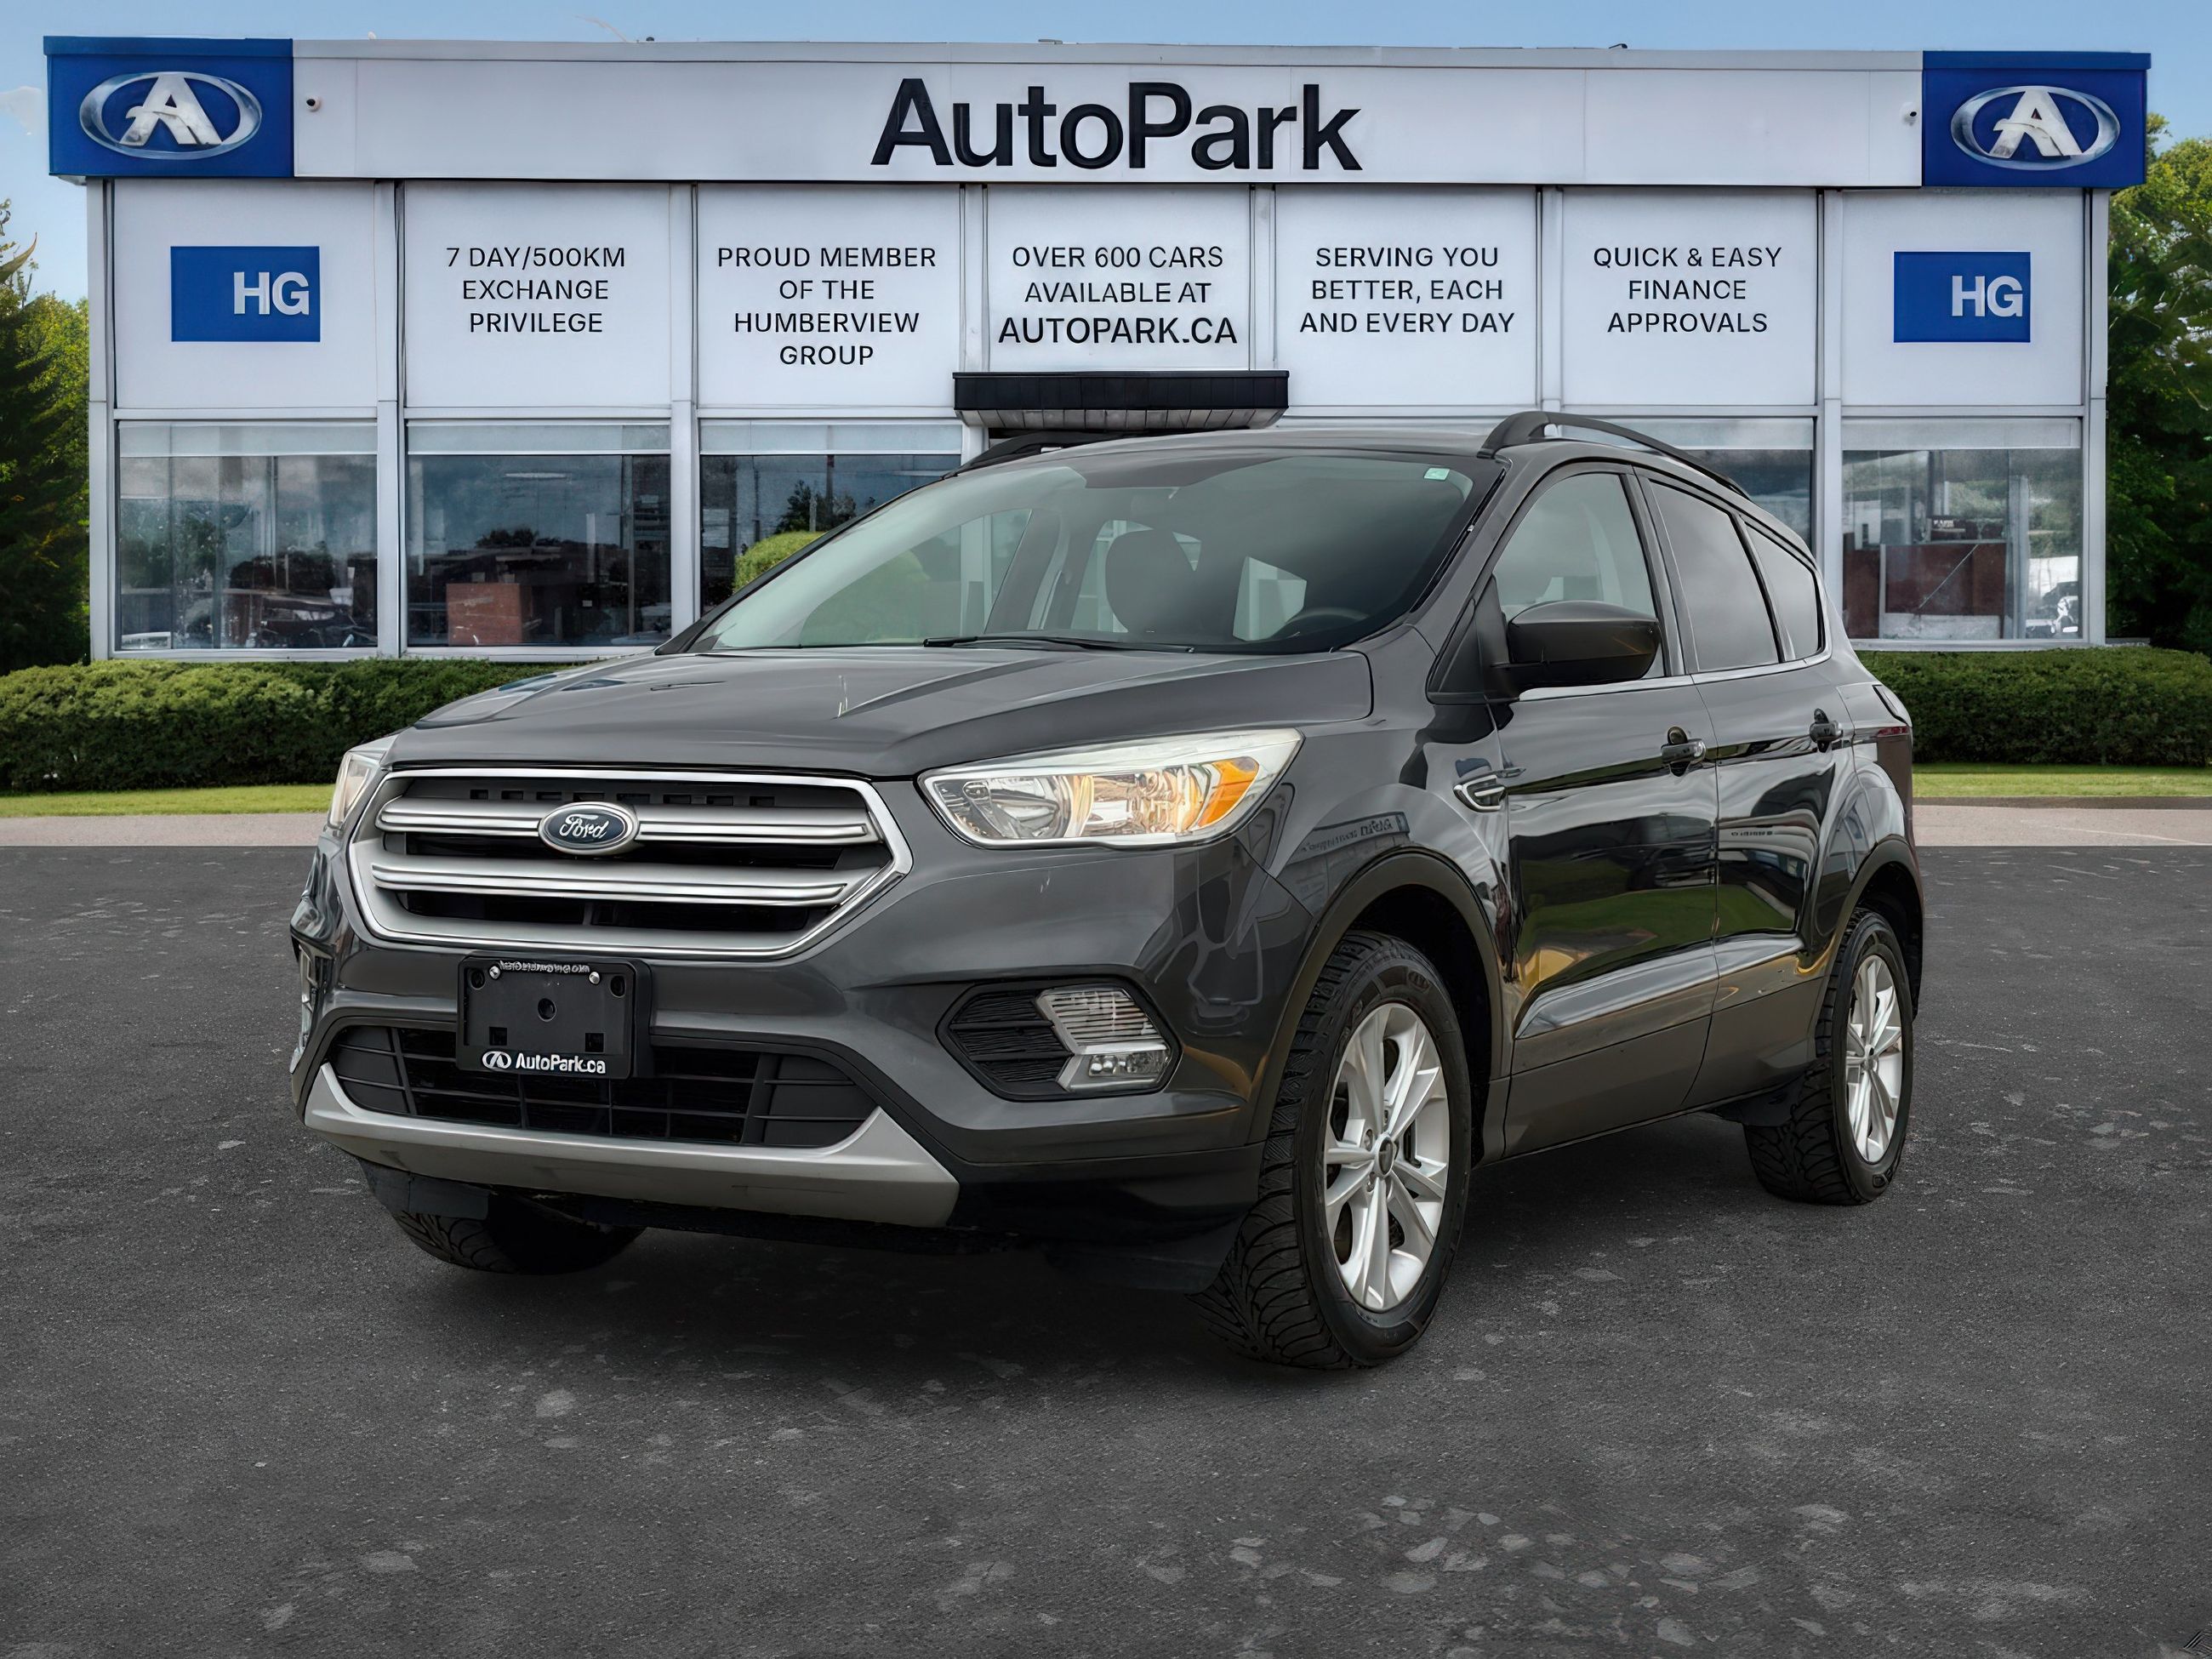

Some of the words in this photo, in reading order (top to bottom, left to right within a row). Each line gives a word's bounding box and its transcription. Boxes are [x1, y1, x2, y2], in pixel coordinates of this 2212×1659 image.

[869, 77, 1363, 171] AutoPark
[446, 247, 461, 267] 7
[468, 246, 625, 271] DAY/500KM
[718, 247, 810, 267] PROUD
[820, 247, 936, 267] MEMBER
[1012, 246, 1086, 268] OVER
[1095, 246, 1141, 268] 600
[1149, 246, 1223, 268] CARS
[1315, 247, 1434, 267] SERVING
[1442, 247, 1498, 267] YOU
[1593, 247, 1679, 269] QUICK
[1687, 247, 1703, 267] &
[1712, 247, 1782, 267] EASY
[233, 271, 310, 316] HG
[463, 279, 609, 300] EXCHANGE
[779, 280, 813, 299] OF
[821, 280, 875, 299] THE
[1024, 282, 1172, 304] AVAILABLE
[1177, 282, 1212, 304] AT
[1312, 280, 1421, 304] BETTER,
[1431, 279, 1502, 300] EACH
[1629, 279, 1747, 300] FINANCE
[1952, 276, 2023, 317] HG
[470, 312, 602, 333] PRIVILEGE
[735, 312, 920, 333] HUMBERVIEW
[998, 316, 1238, 345] AUTOPARK.CA
[1299, 312, 1357, 333] AND
[1366, 312, 1453, 333] EVERY
[1461, 312, 1515, 333] DAY
[1607, 312, 1767, 333] APPROVALS
[779, 345, 874, 366] GROUP
[559, 813, 609, 839] Ford
[515, 1052, 607, 1075] AutoPark.ca
